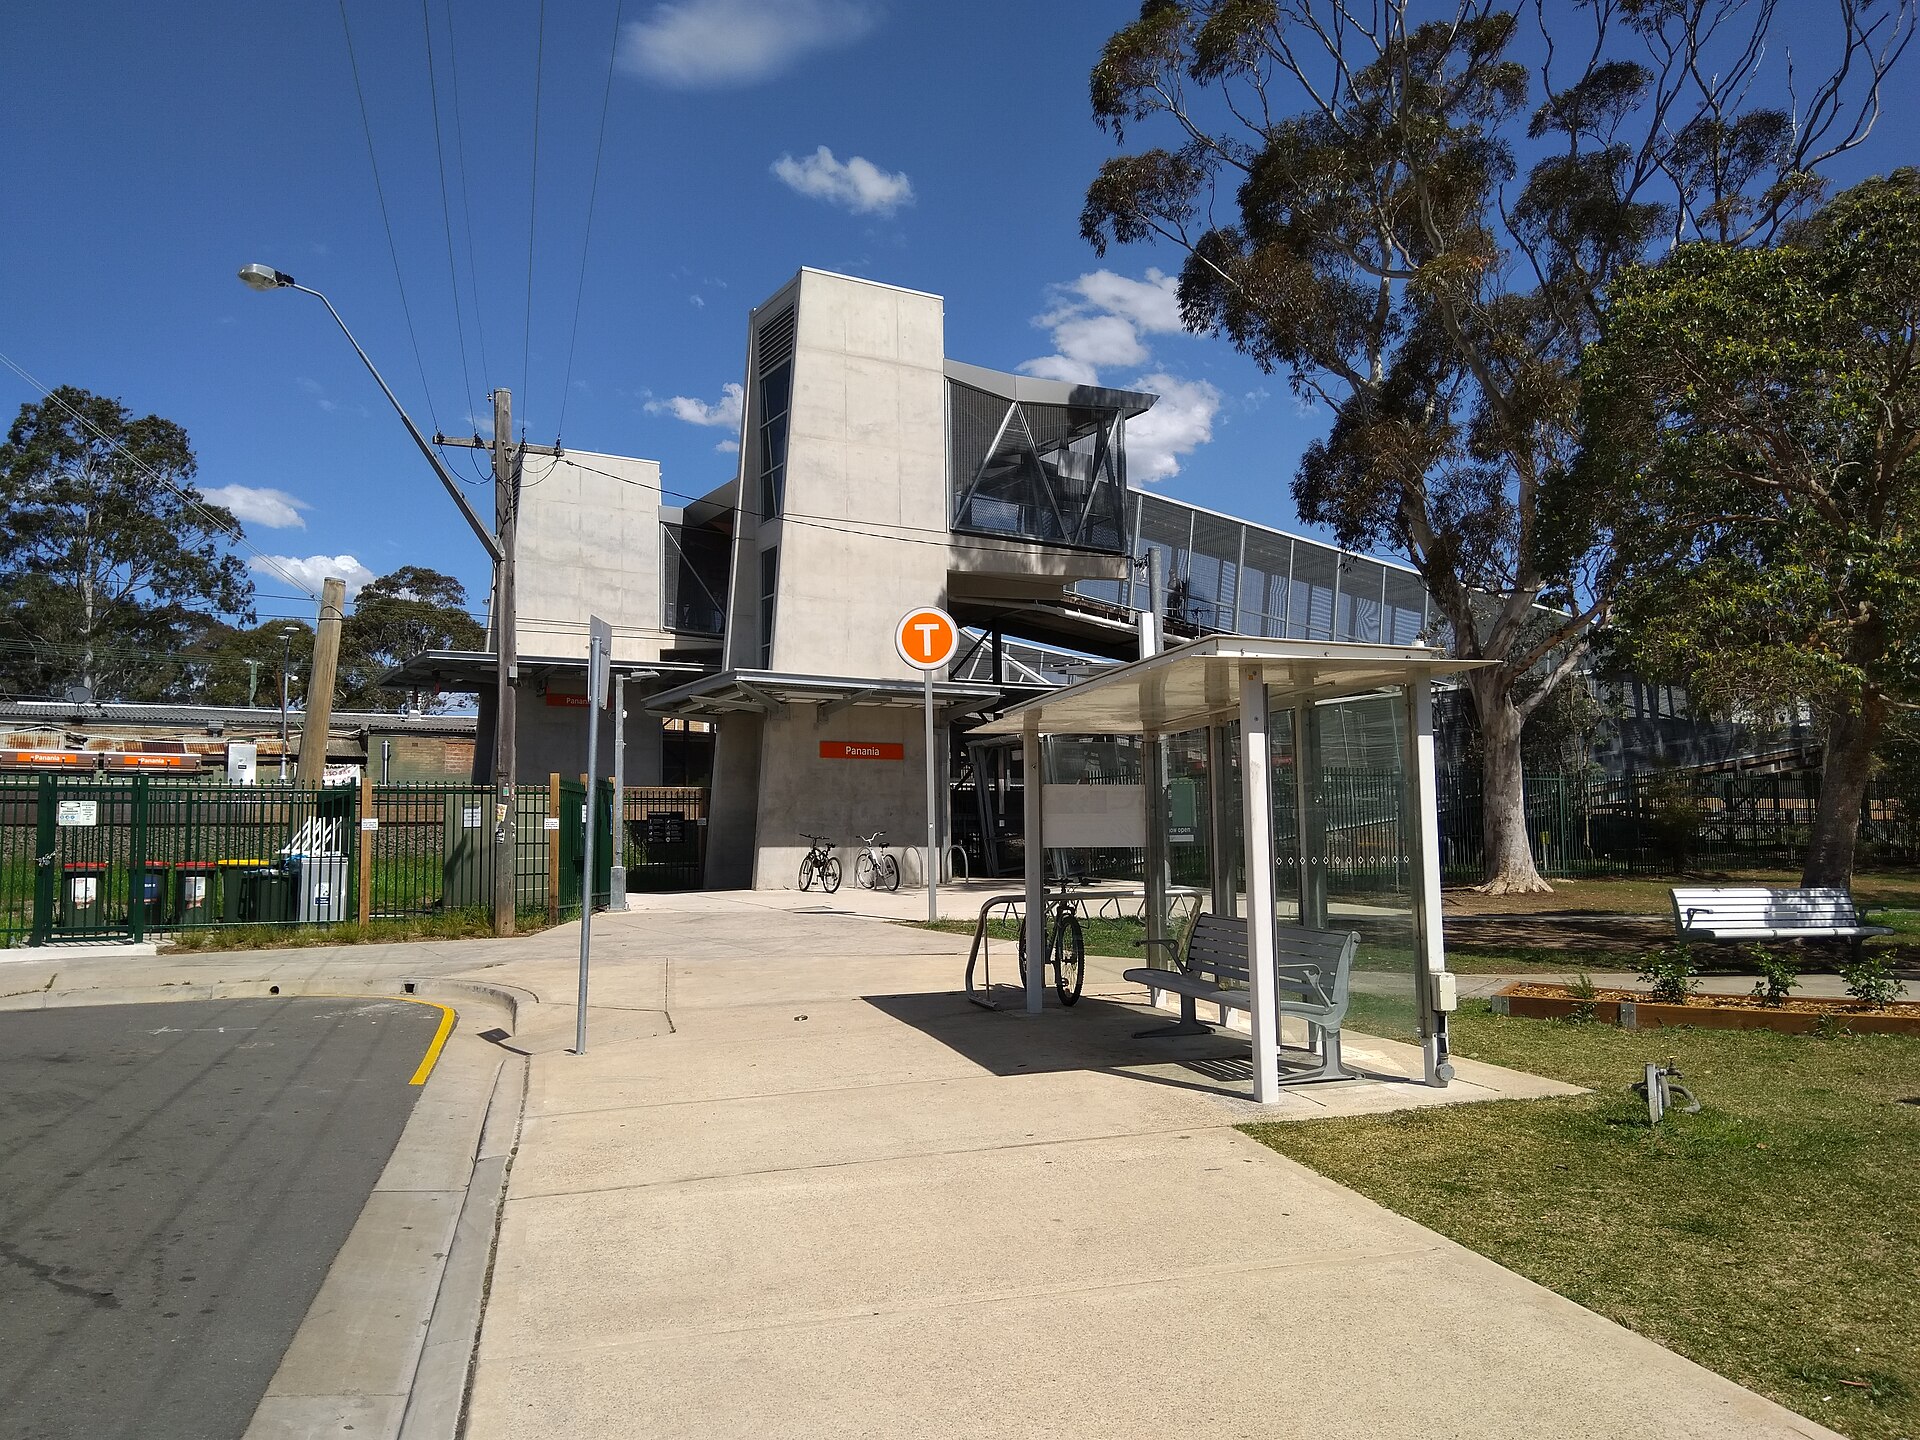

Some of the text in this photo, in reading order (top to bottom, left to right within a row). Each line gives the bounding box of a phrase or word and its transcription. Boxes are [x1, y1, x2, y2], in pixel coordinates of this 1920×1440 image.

[914, 623, 939, 656] T
[566, 697, 588, 705] Panan
[845, 746, 880, 756] Panania
